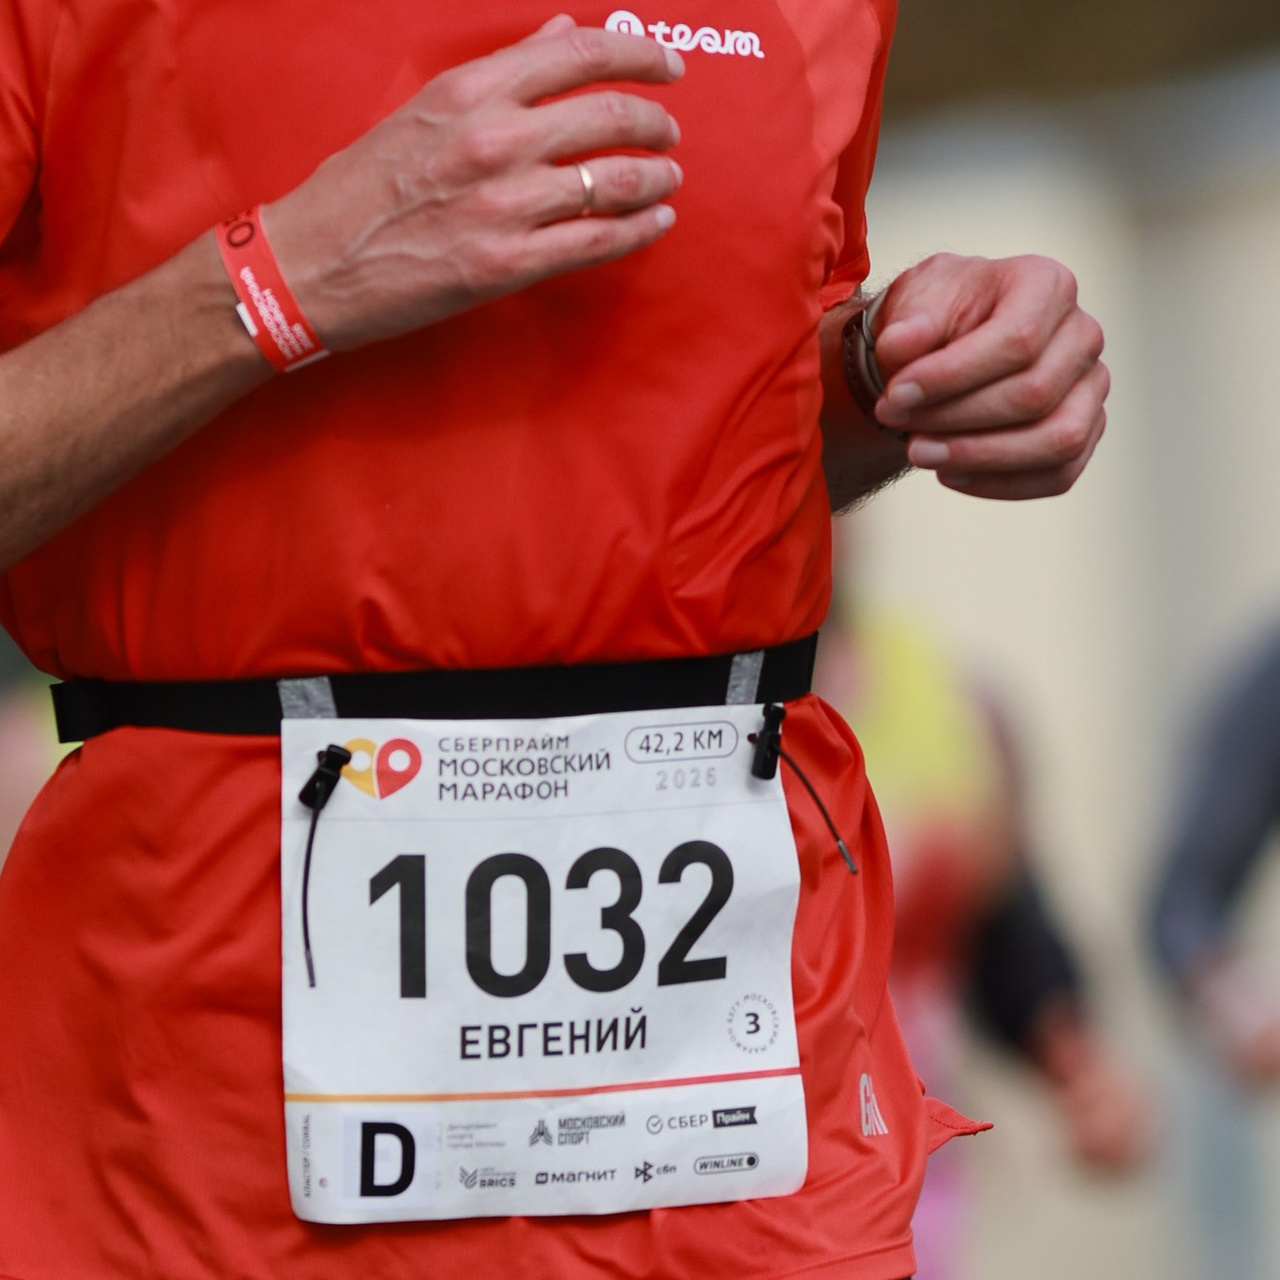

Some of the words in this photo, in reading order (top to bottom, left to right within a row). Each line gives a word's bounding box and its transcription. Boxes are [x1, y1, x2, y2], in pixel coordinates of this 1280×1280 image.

[647, 20, 765, 59] team
[437, 733, 571, 753] СБЕРПРАЙМ
[638, 731, 684, 754] 42,2
[693, 729, 723, 750] КМ
[437, 748, 611, 777] МОСКОВСКИЙ
[437, 781, 569, 801] МАРАФОН
[369, 840, 735, 999] 1032
[460, 1007, 647, 1060] ЕВГЕНИЙ
[745, 1012, 761, 1035] 3
[558, 1111, 625, 1130] МОСКОВСКИЙ
[667, 1114, 708, 1130] СБЕР
[558, 1131, 590, 1146] СПОРТ
[359, 1122, 416, 1197] D
[656, 1164, 677, 1175] сбп
[699, 1157, 744, 1171] WINLINE
